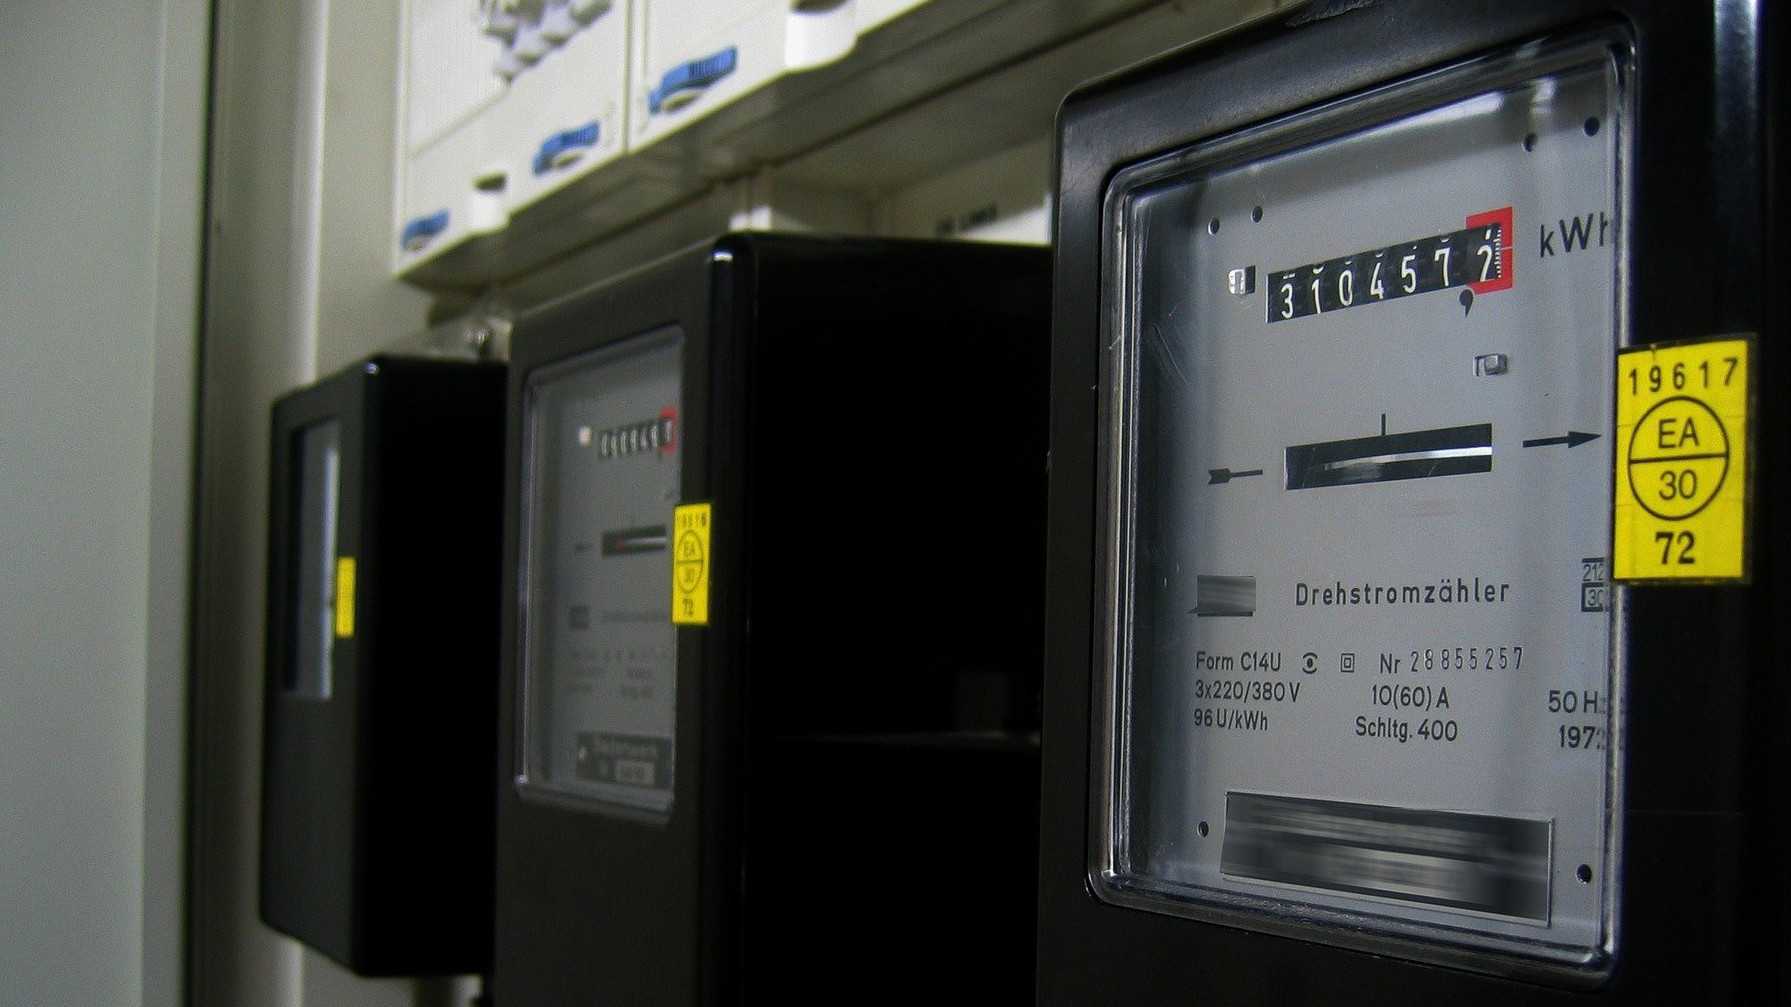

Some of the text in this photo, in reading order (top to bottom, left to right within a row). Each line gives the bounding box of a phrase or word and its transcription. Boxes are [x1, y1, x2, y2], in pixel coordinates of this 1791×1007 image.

[1628, 357, 1738, 396] 19617
[1658, 417, 1700, 449] EA
[1659, 469, 1697, 501] 30
[1655, 531, 1696, 565] 72
[1296, 577, 1509, 606] Drehstromzähler
[1196, 646, 1523, 674] Form C14U Nr 28855257
[1195, 679, 1301, 703] 3x220/380 V
[1372, 684, 1449, 711] 10(60) A
[1549, 690, 1577, 714] 50
[1194, 708, 1268, 731] 96 U/kWh
[1417, 719, 1457, 741] 400
